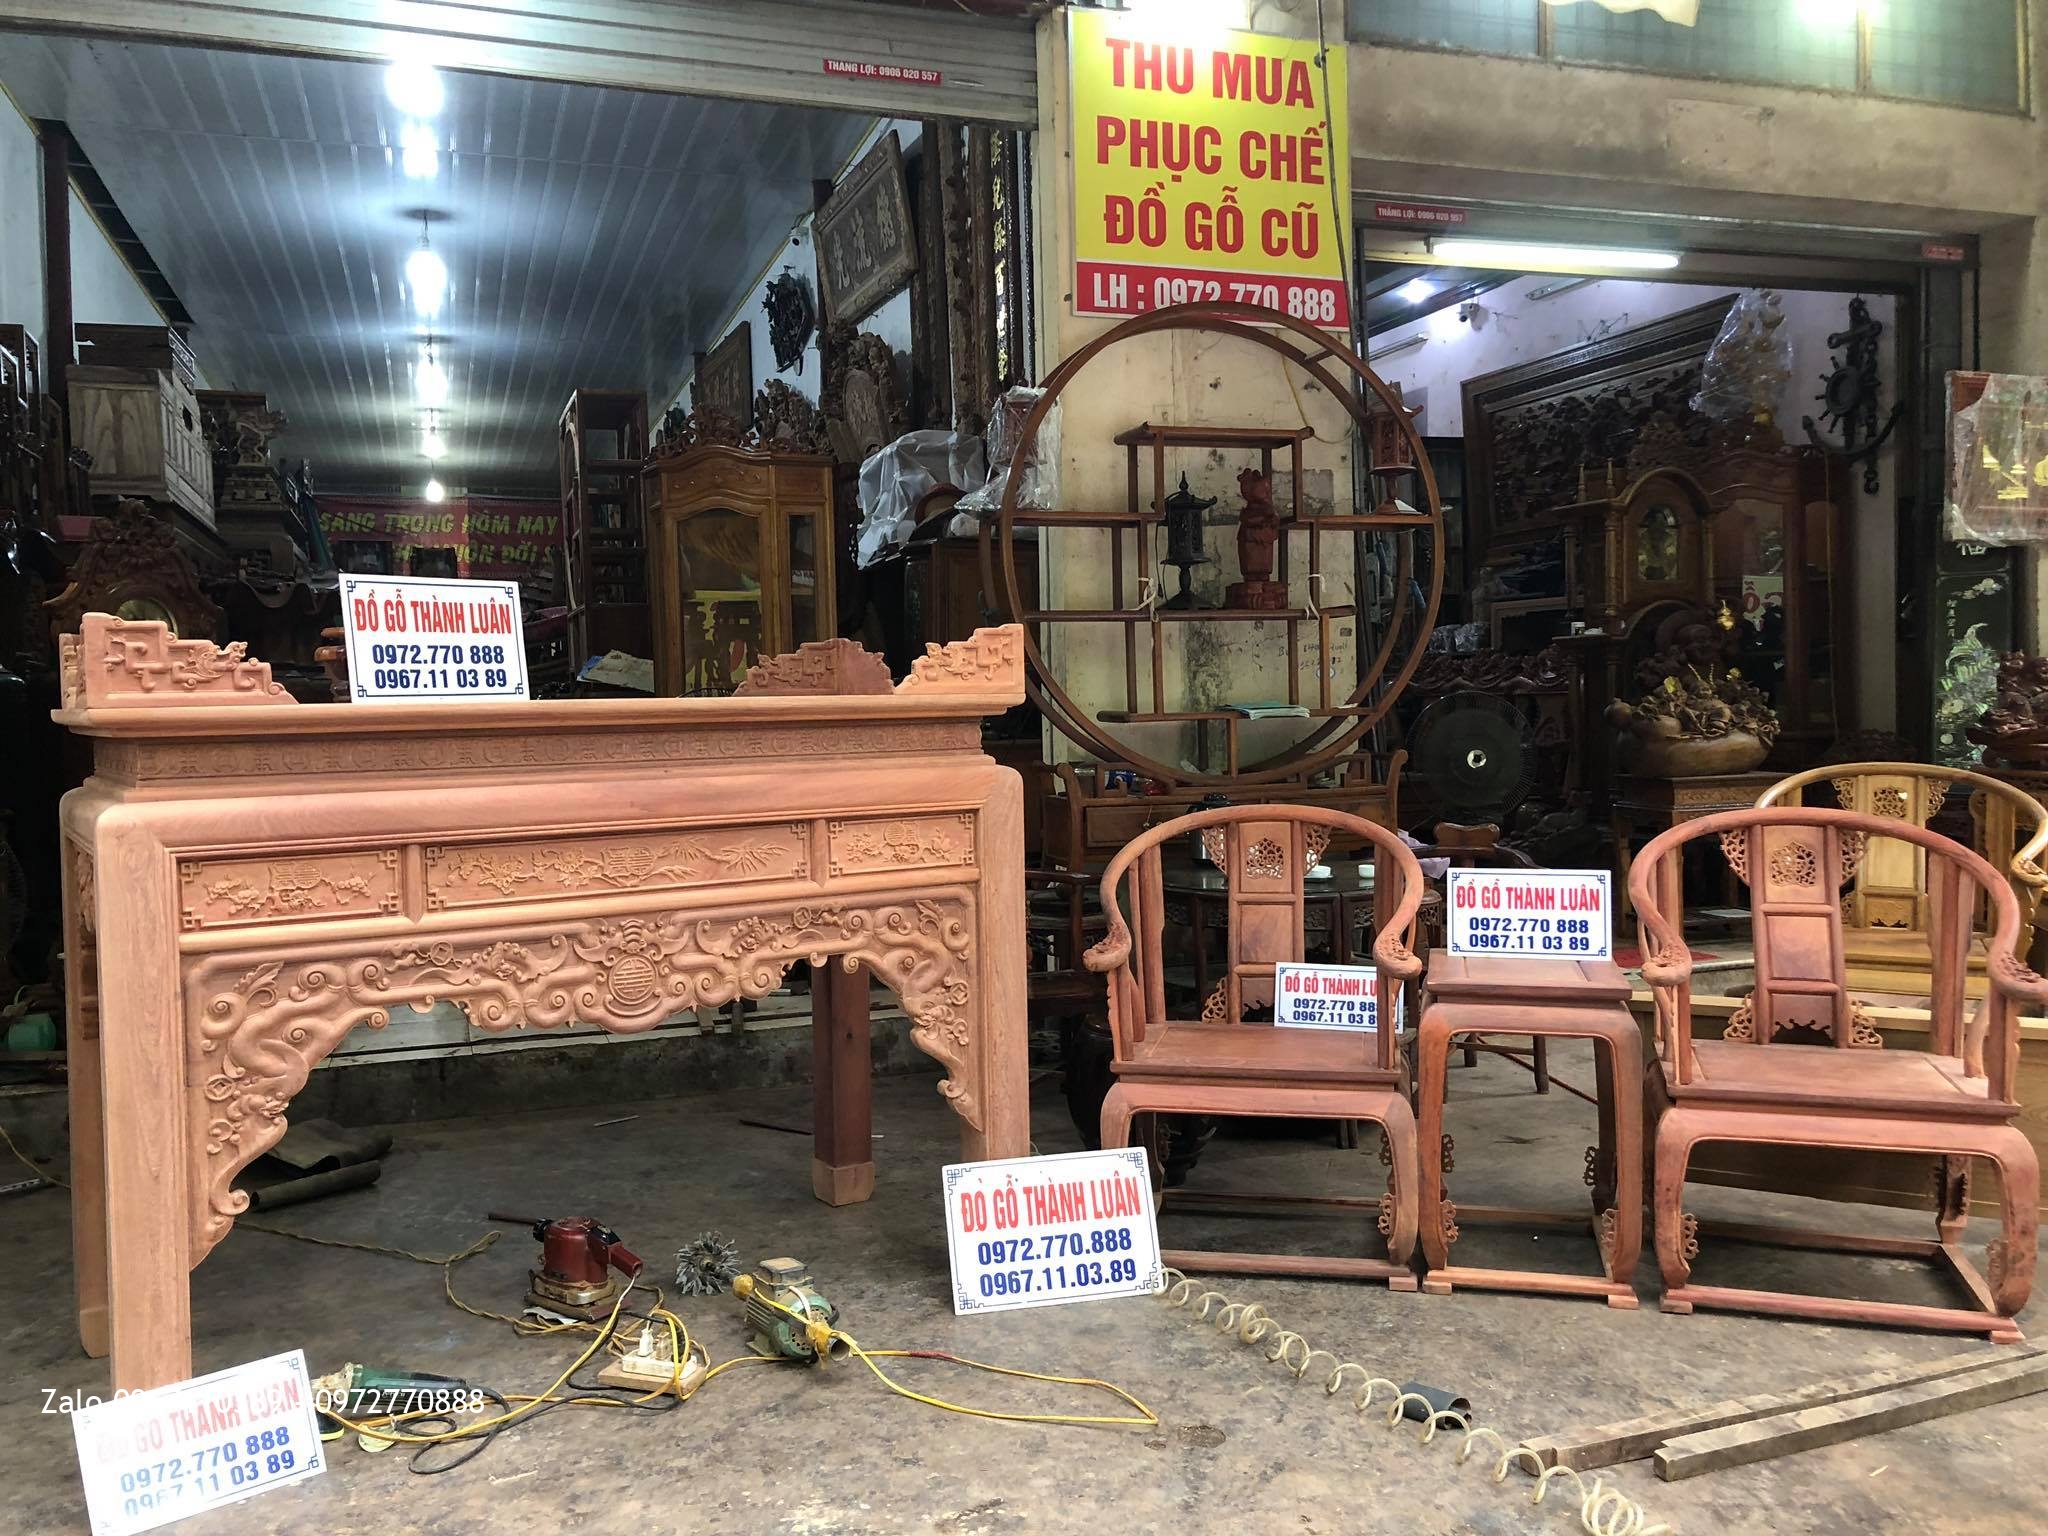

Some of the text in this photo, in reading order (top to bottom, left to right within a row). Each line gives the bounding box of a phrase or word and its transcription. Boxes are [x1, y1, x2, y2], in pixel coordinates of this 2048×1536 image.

[1106, 38, 1315, 109] THU MUA
[1096, 115, 1326, 185] PHỤC CHẾ
[1104, 181, 1319, 259] ĐỒ GỖ CŨ
[1093, 272, 1128, 310] LH
[1288, 286, 1336, 322] 888
[517, 515, 560, 536] NAY
[354, 588, 512, 634] ĐỒ GỖ THÀNH LUÂN
[372, 644, 505, 664] 0972.770 888
[375, 668, 507, 689] 0967.11 03 89
[1456, 878, 1601, 912] ĐỒ GỖ THÀNH LUÂN
[1469, 917, 1589, 934] 0972.770 888
[1469, 934, 1590, 951] 0967.11 03 89
[1293, 998, 1378, 1013] 0972.770 88
[1361, 978, 1378, 997] LU
[1293, 1010, 1343, 1024] 0967.11
[1347, 1013, 1364, 1025] 03
[993, 1174, 1019, 1230] GỖ
[1023, 1177, 1087, 1226] THÀNH
[1090, 1170, 1142, 1219] LUÂN
[978, 1227, 1132, 1265] 0972.770.888
[979, 1258, 1137, 1297] 0967.11.03.89
[120, 1426, 290, 1494] 0972.770 888
[231, 1460, 260, 1486] 03
[267, 1449, 296, 1475] 89
